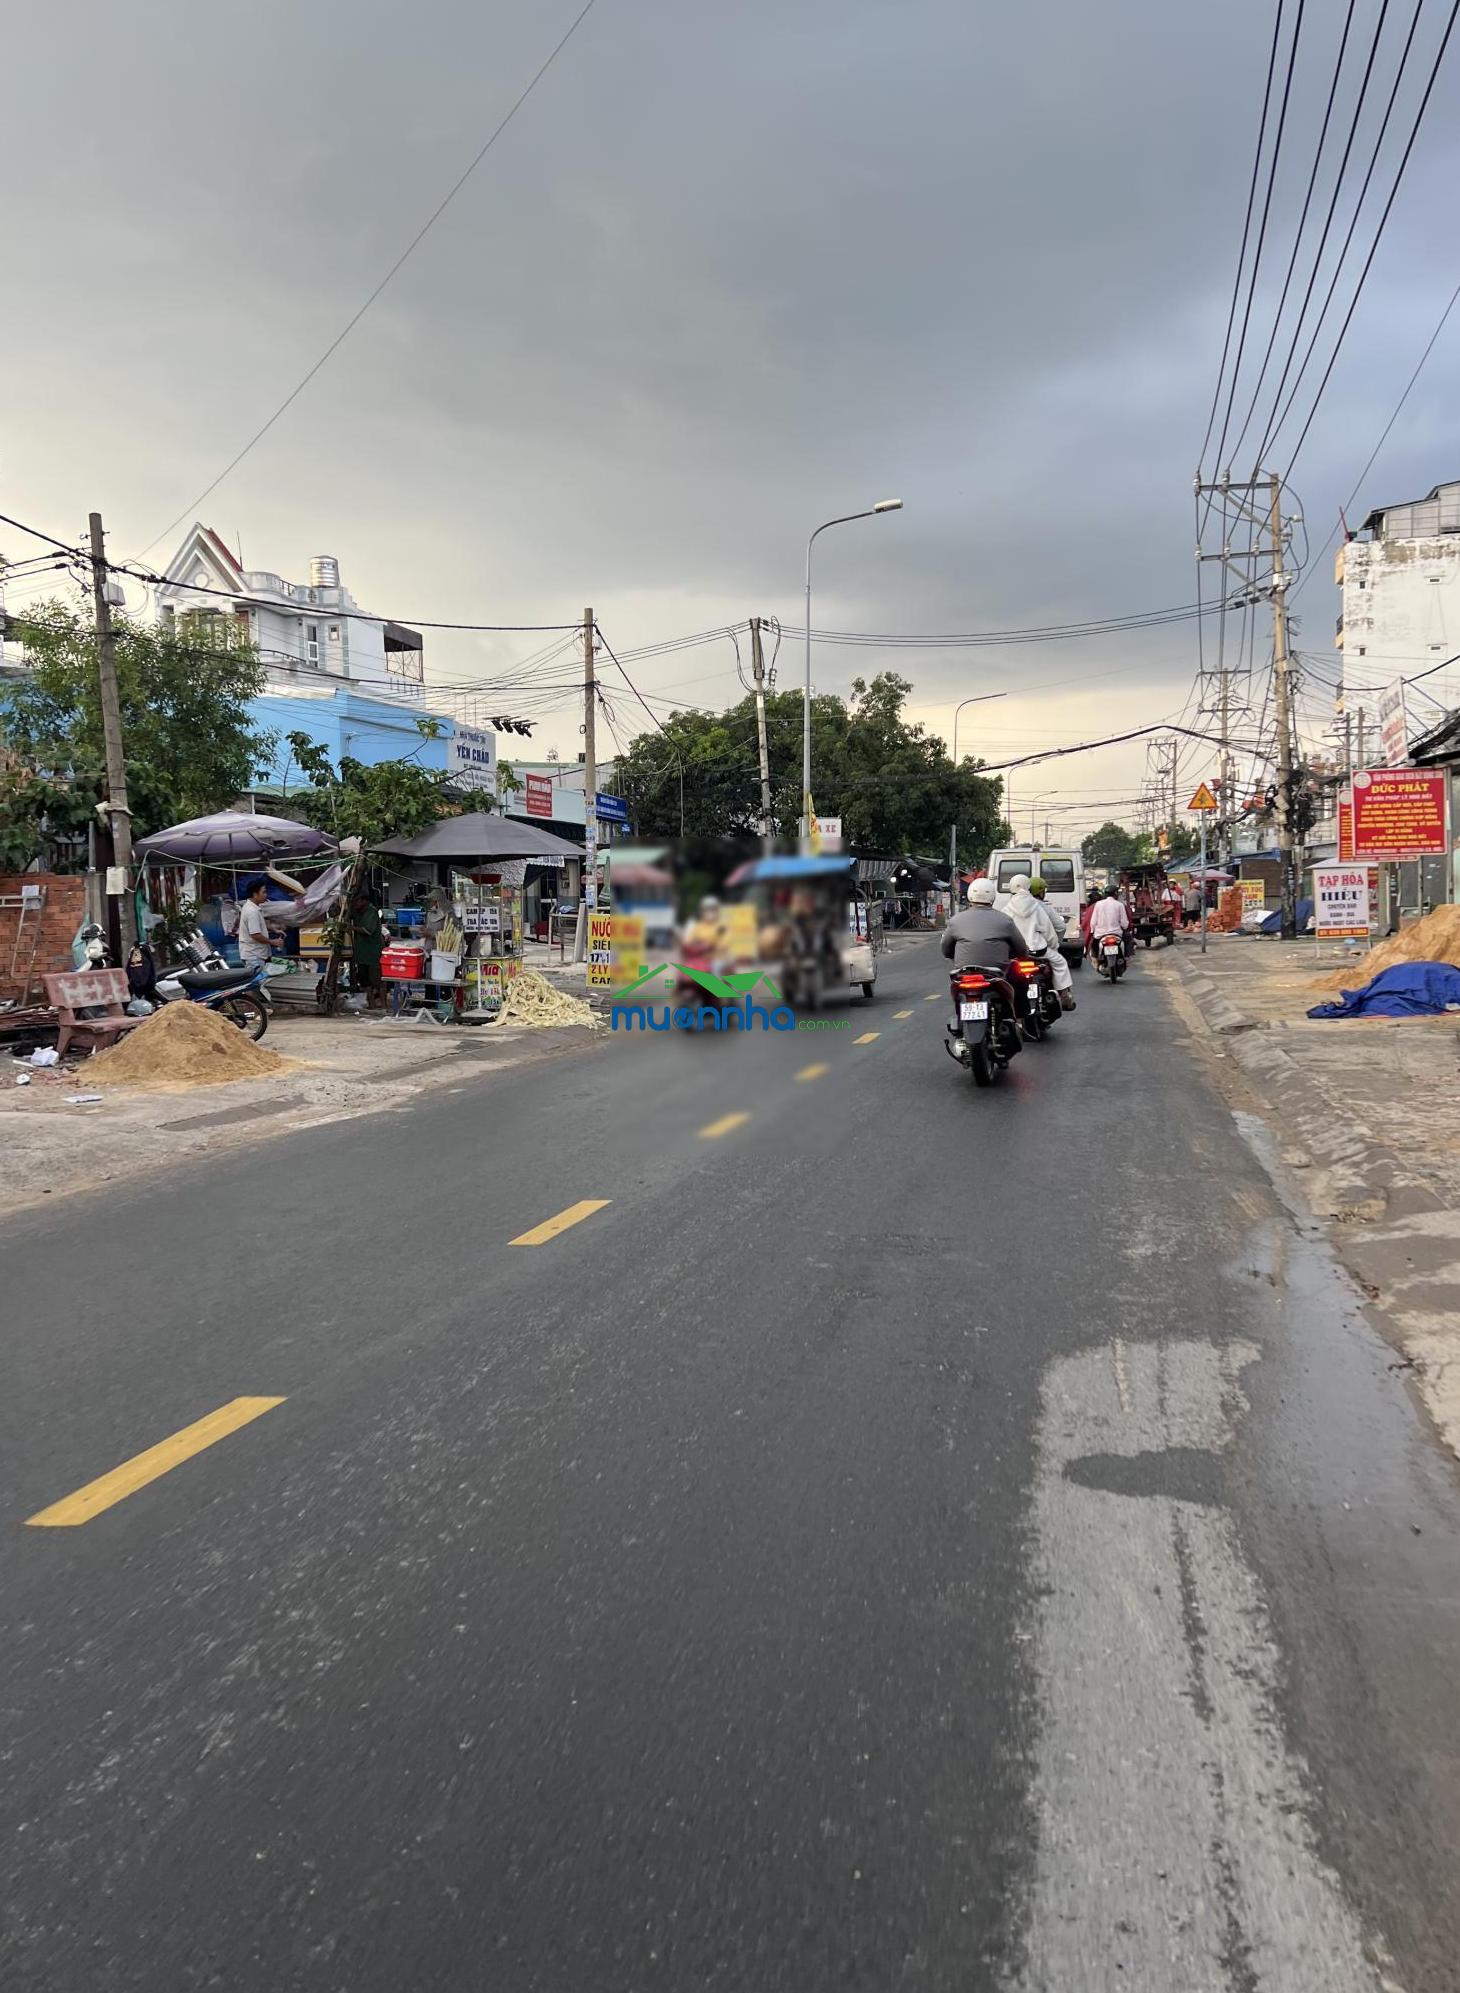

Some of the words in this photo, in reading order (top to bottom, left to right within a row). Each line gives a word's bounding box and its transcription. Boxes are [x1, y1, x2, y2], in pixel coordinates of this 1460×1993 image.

[1371, 782, 1396, 794] ĐỨC
[825, 824, 837, 833] XE
[592, 917, 610, 937] NƯỚ
